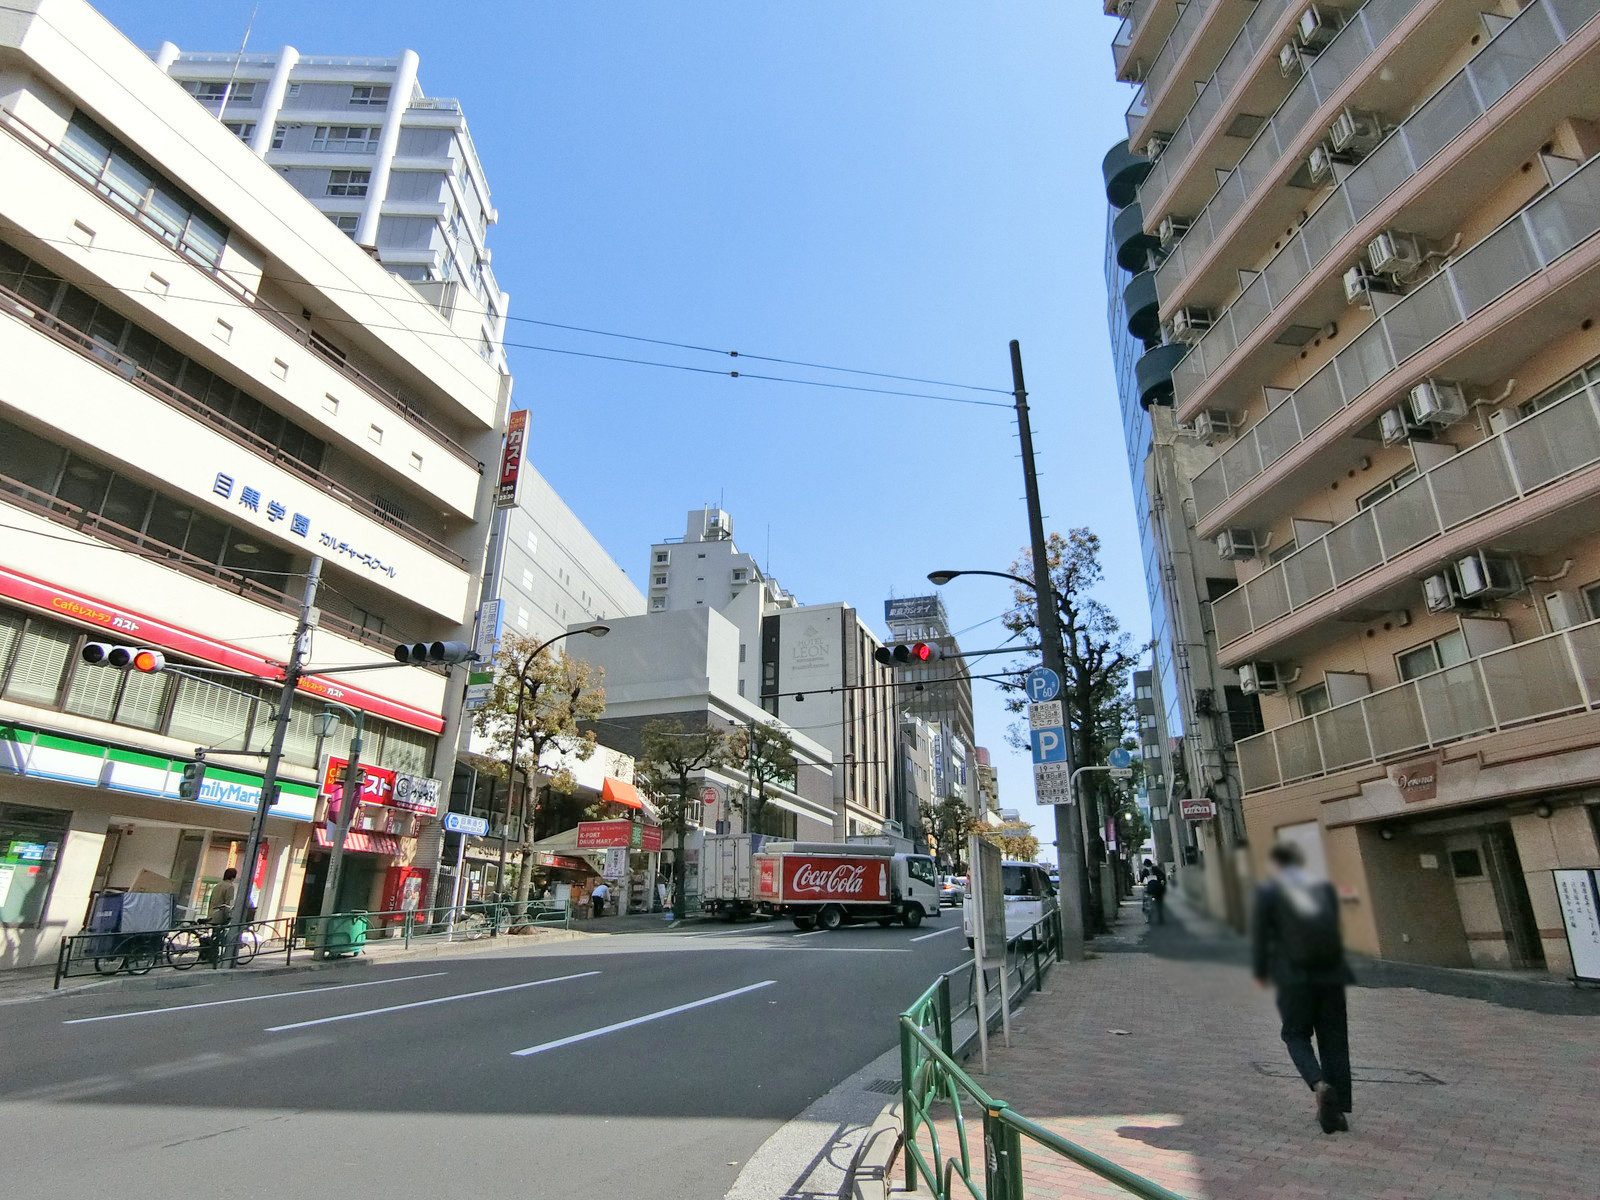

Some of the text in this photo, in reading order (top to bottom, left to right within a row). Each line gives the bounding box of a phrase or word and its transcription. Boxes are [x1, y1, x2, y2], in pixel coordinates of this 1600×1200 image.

[505, 428, 524, 477] ガスト
[213, 472, 397, 579] 目黒学園 カルチャースクール
[112, 617, 140, 631] ガスト
[1033, 677, 1046, 699] P
[1042, 687, 1053, 698] 60
[1032, 719, 1060, 727] ここから
[1038, 731, 1059, 760] P
[1039, 796, 1069, 804] ここから
